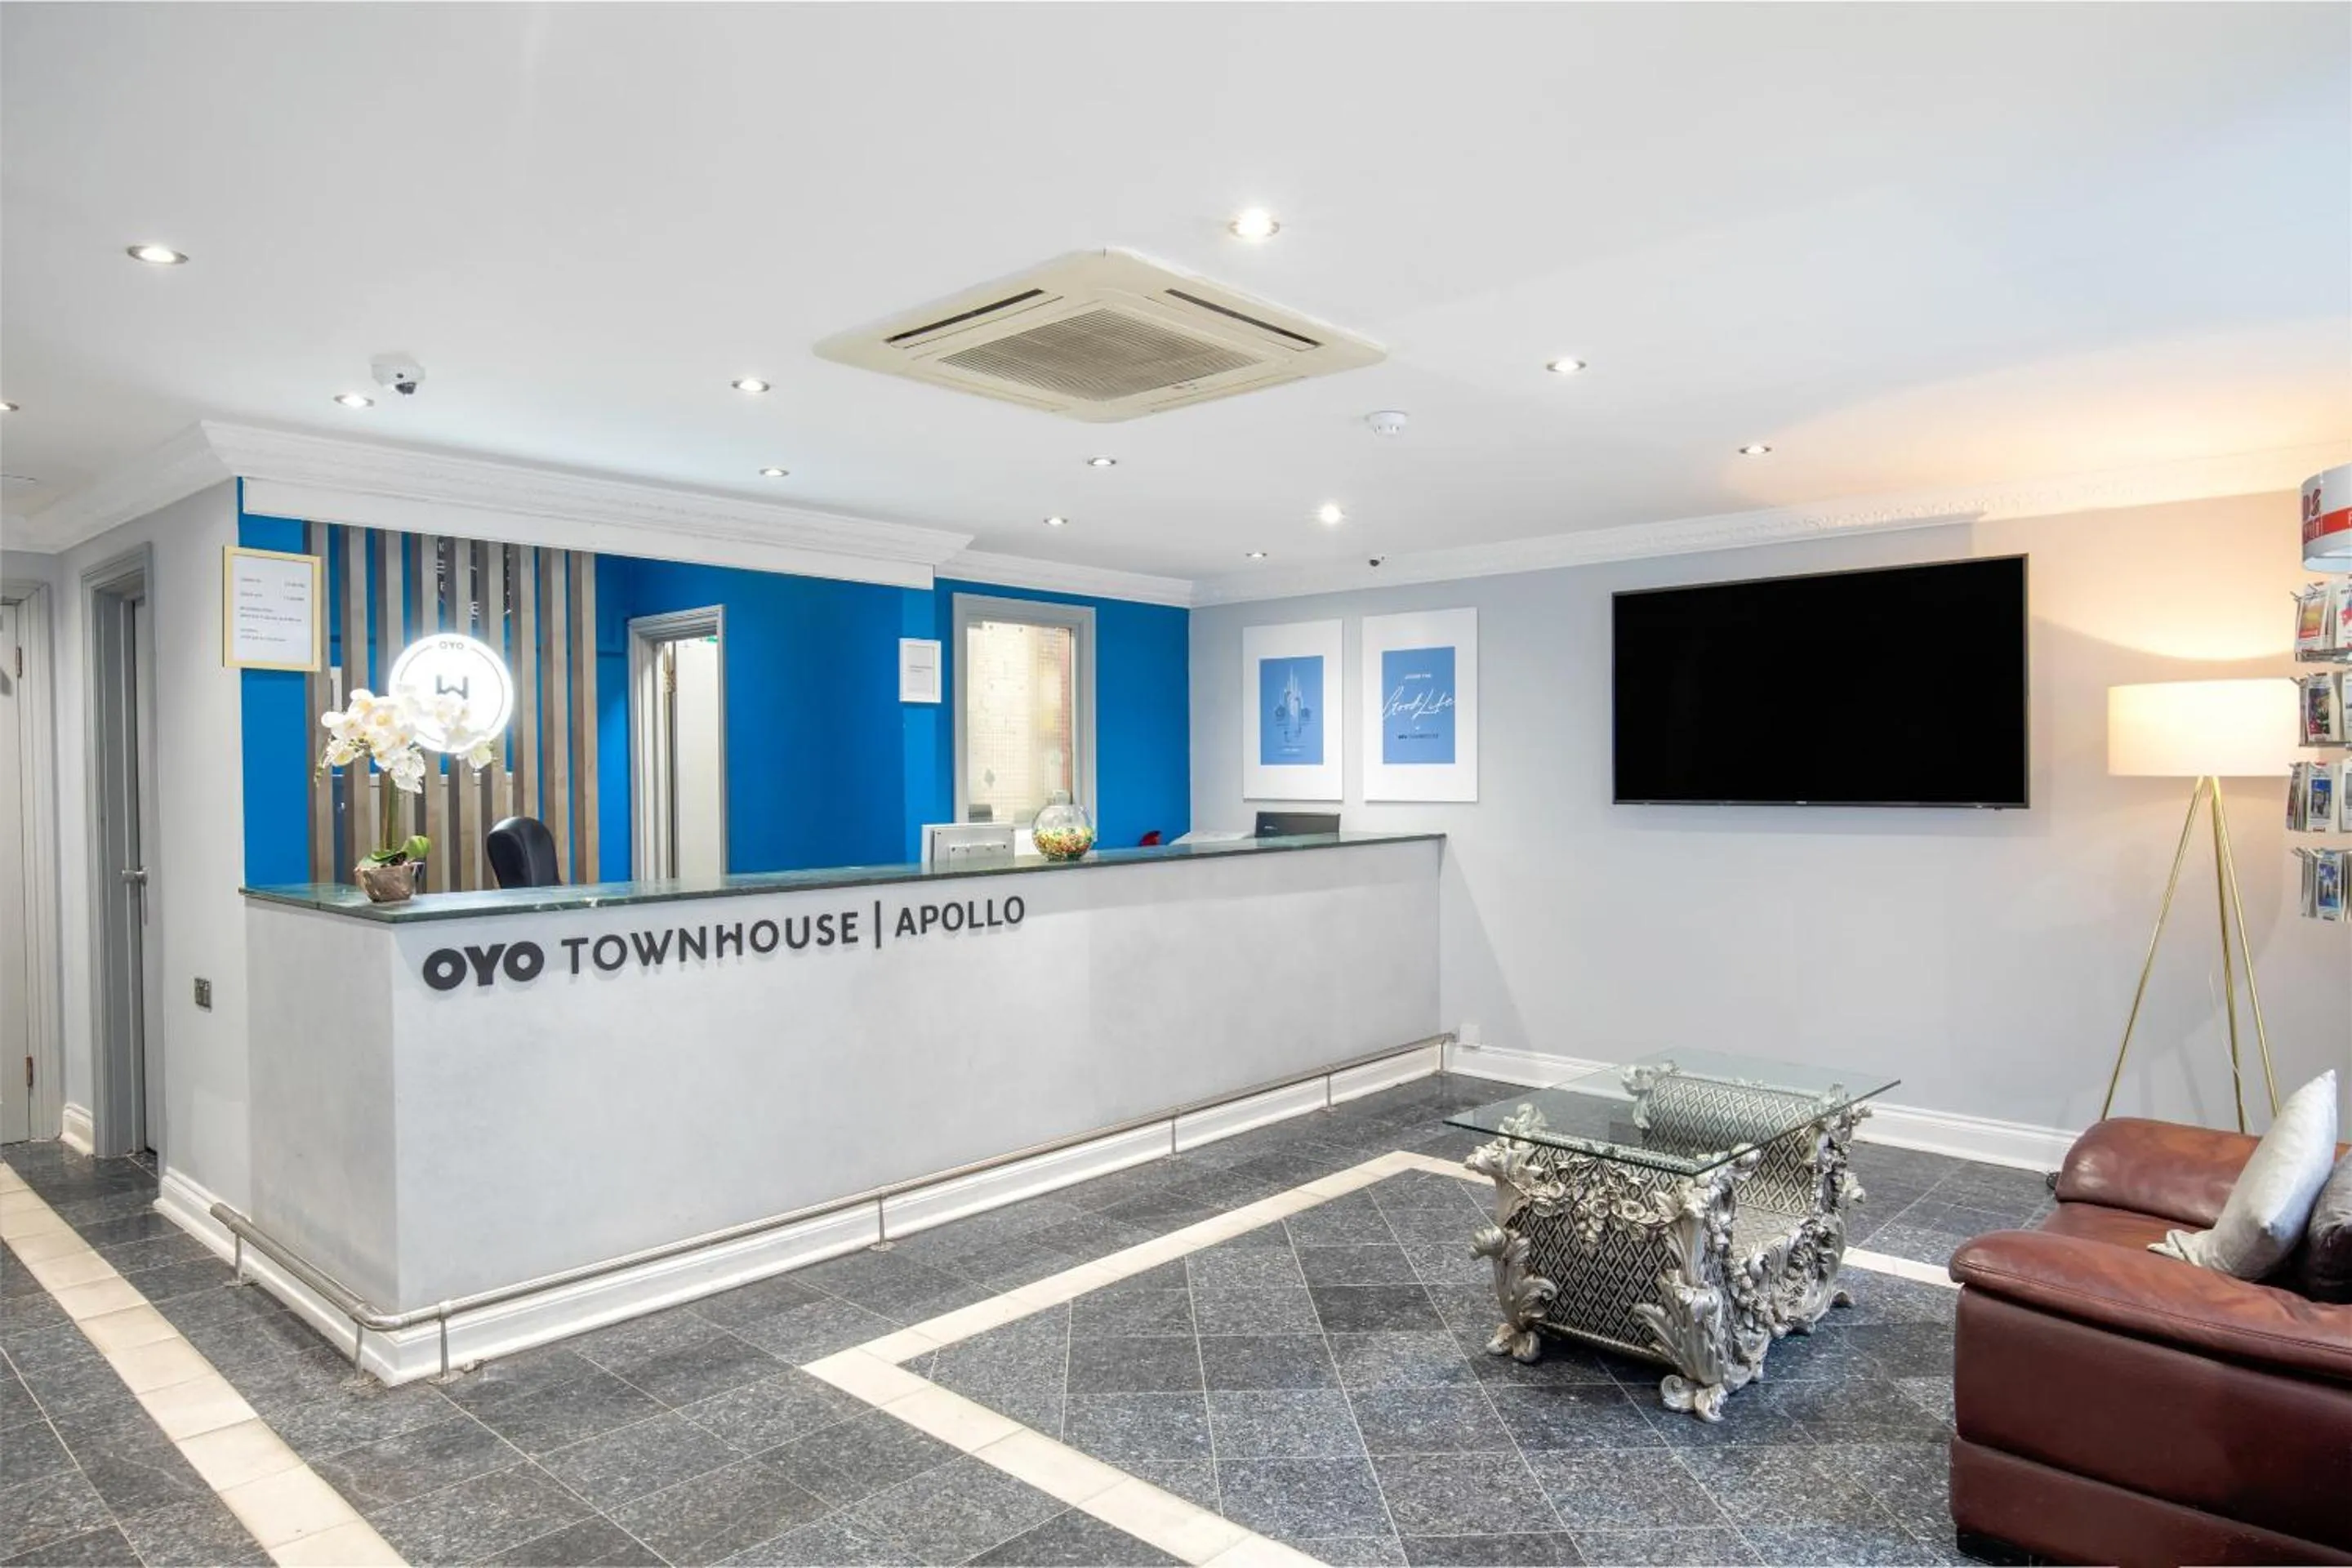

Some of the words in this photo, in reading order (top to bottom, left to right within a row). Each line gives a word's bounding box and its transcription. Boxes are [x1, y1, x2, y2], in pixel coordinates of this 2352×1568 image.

[439, 640, 465, 650] OYO
[422, 941, 545, 991] OYO
[561, 911, 858, 974] TOWNHOUSE
[895, 896, 1025, 938] APOLLO
